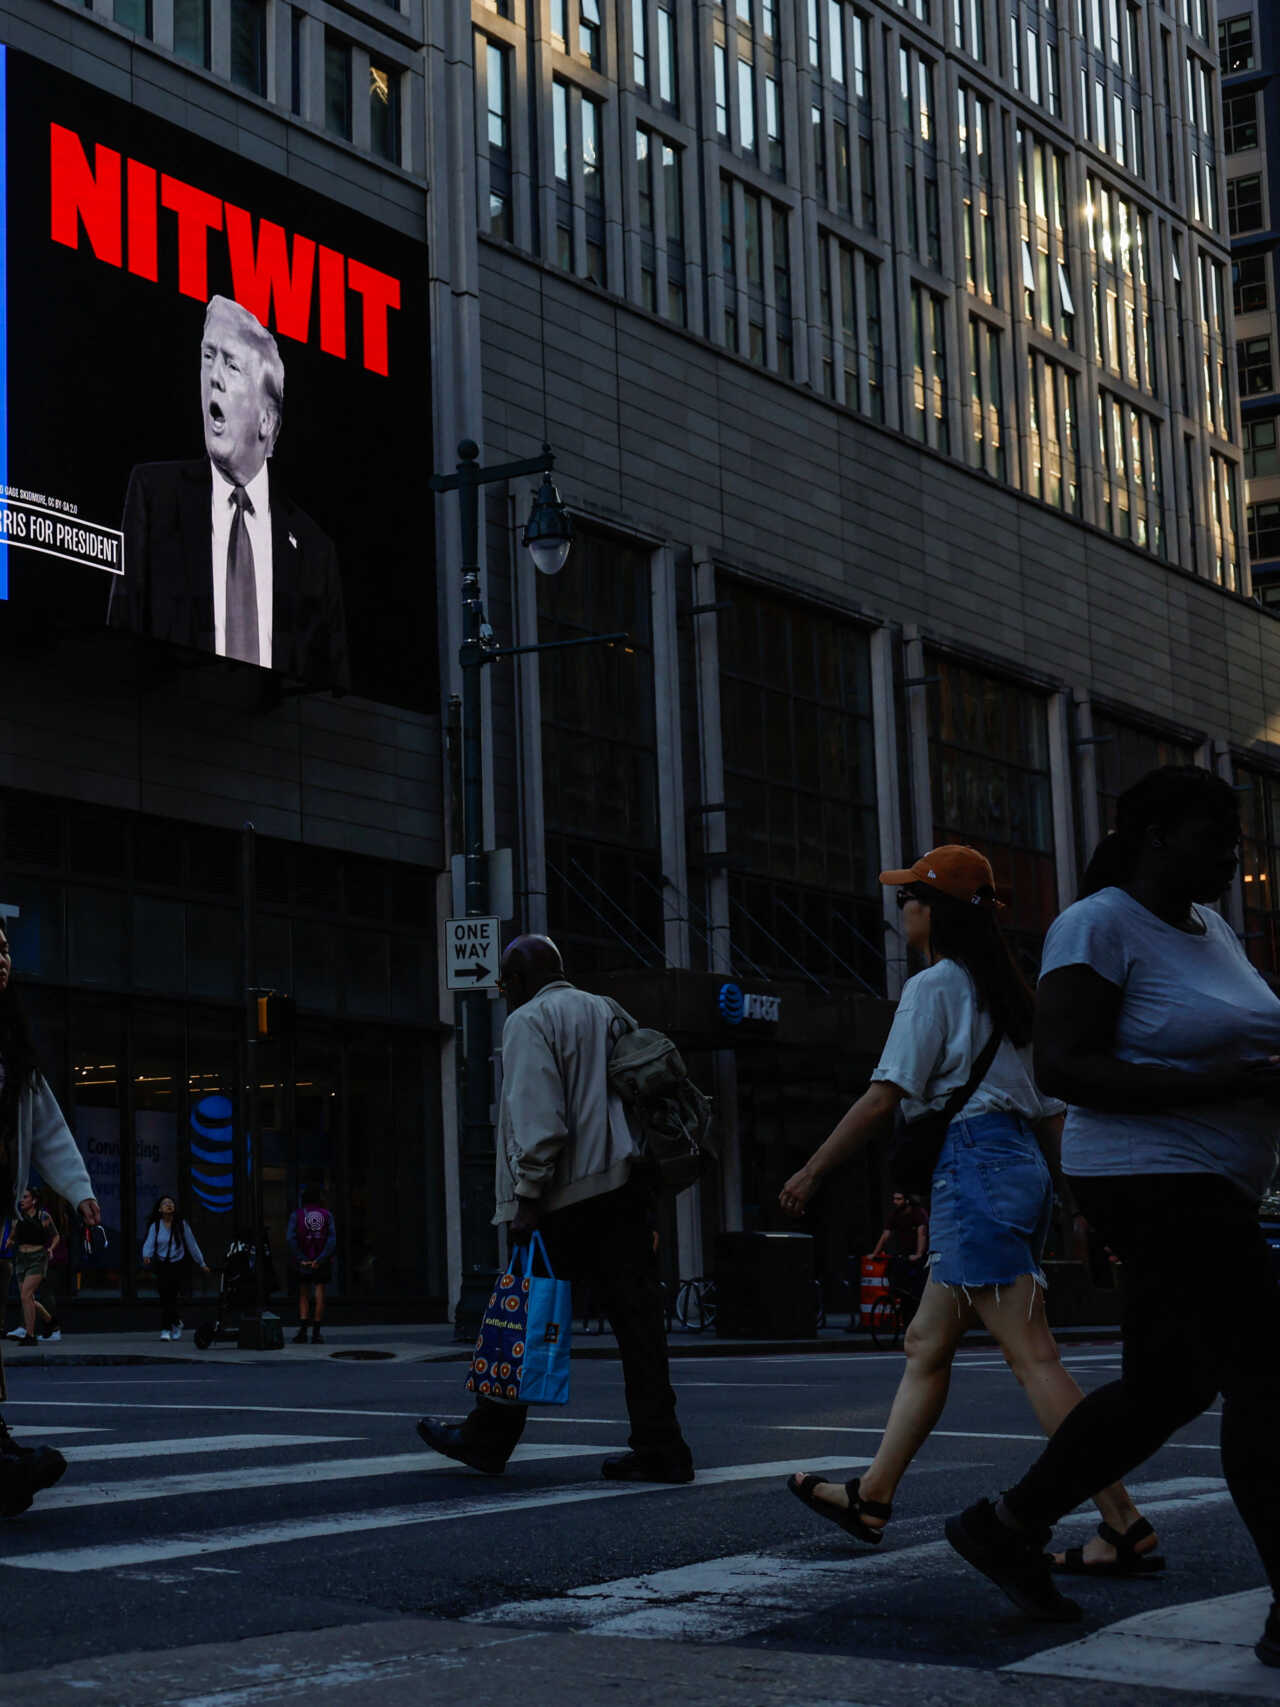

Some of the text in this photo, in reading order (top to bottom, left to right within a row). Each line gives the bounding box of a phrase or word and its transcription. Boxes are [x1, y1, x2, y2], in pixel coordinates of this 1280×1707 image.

[49, 121, 401, 378] NITWIT
[30, 516, 53, 546] FOR
[56, 522, 118, 564] PRESIDENT
[455, 923, 489, 940] ONE
[455, 942, 490, 960] WAY
